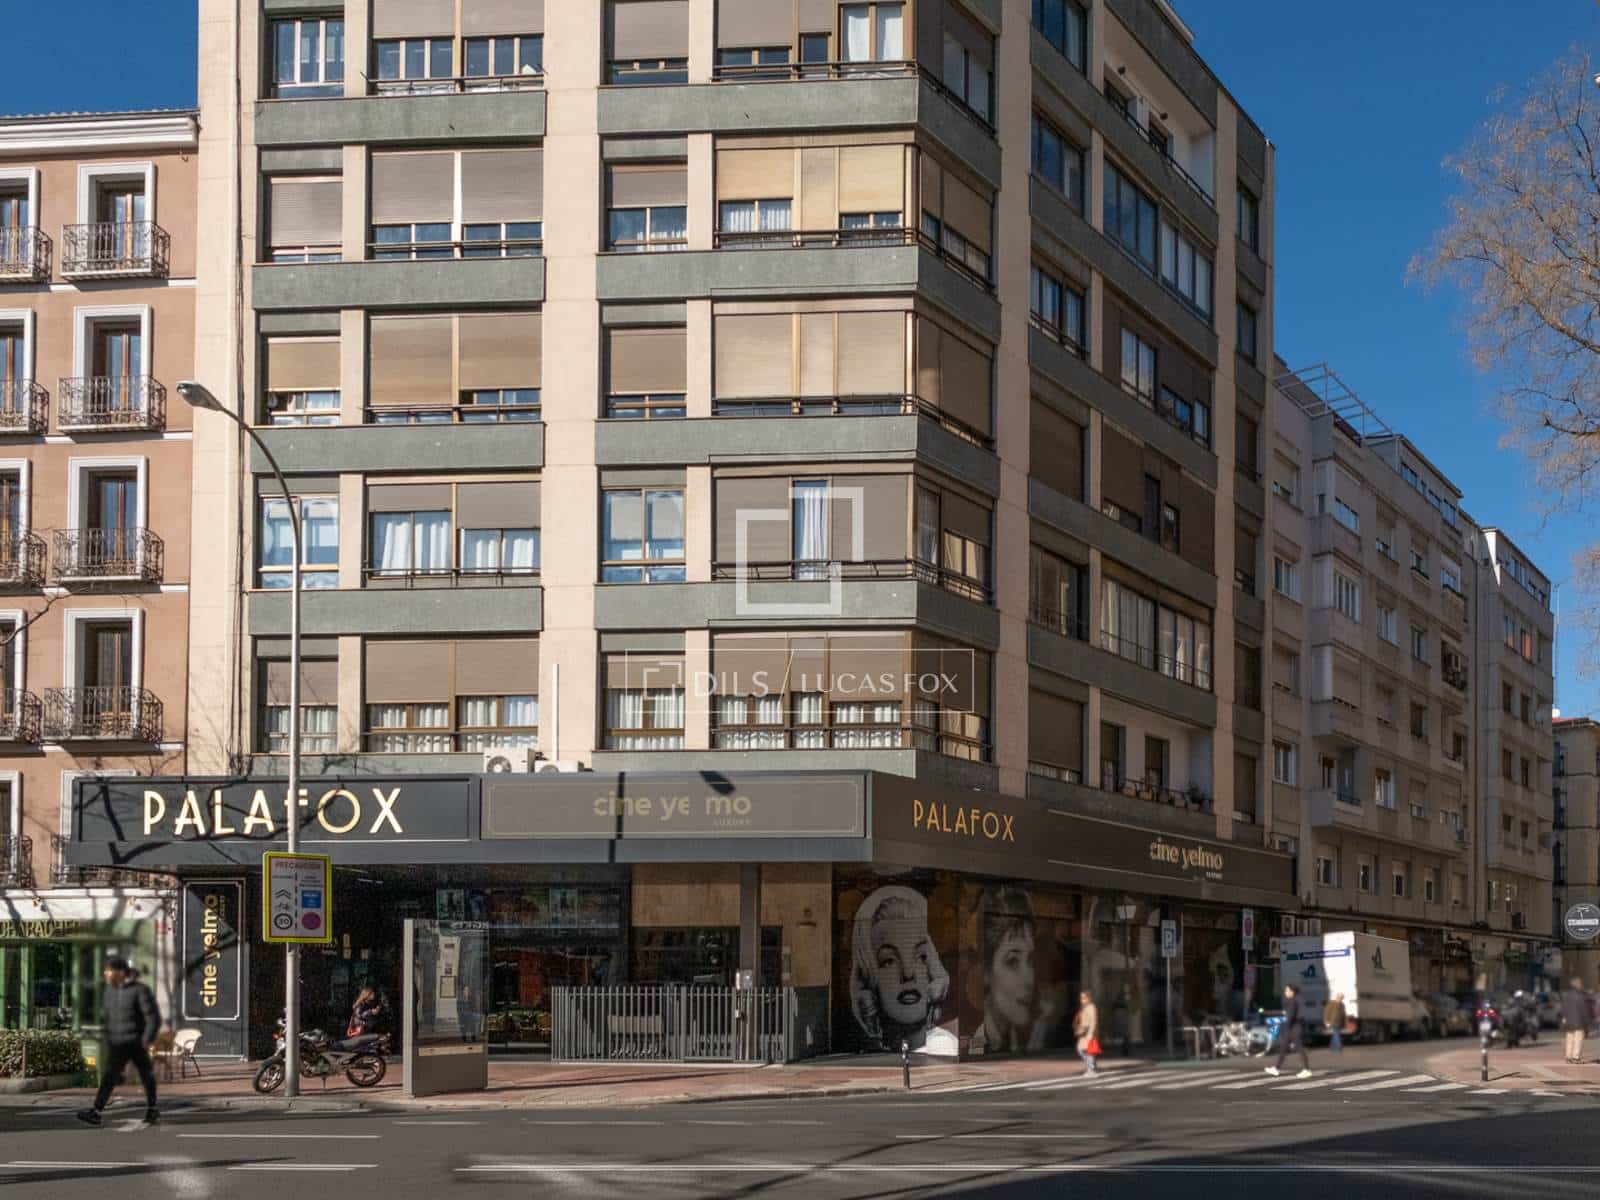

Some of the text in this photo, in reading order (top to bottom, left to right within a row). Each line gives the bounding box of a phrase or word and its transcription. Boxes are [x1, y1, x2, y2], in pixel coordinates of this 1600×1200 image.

[593, 790, 652, 816] cine
[913, 799, 1015, 842] PALAFOX
[1150, 837, 1224, 870] cine yelmo
[200, 895, 221, 1008] cine yelmo
